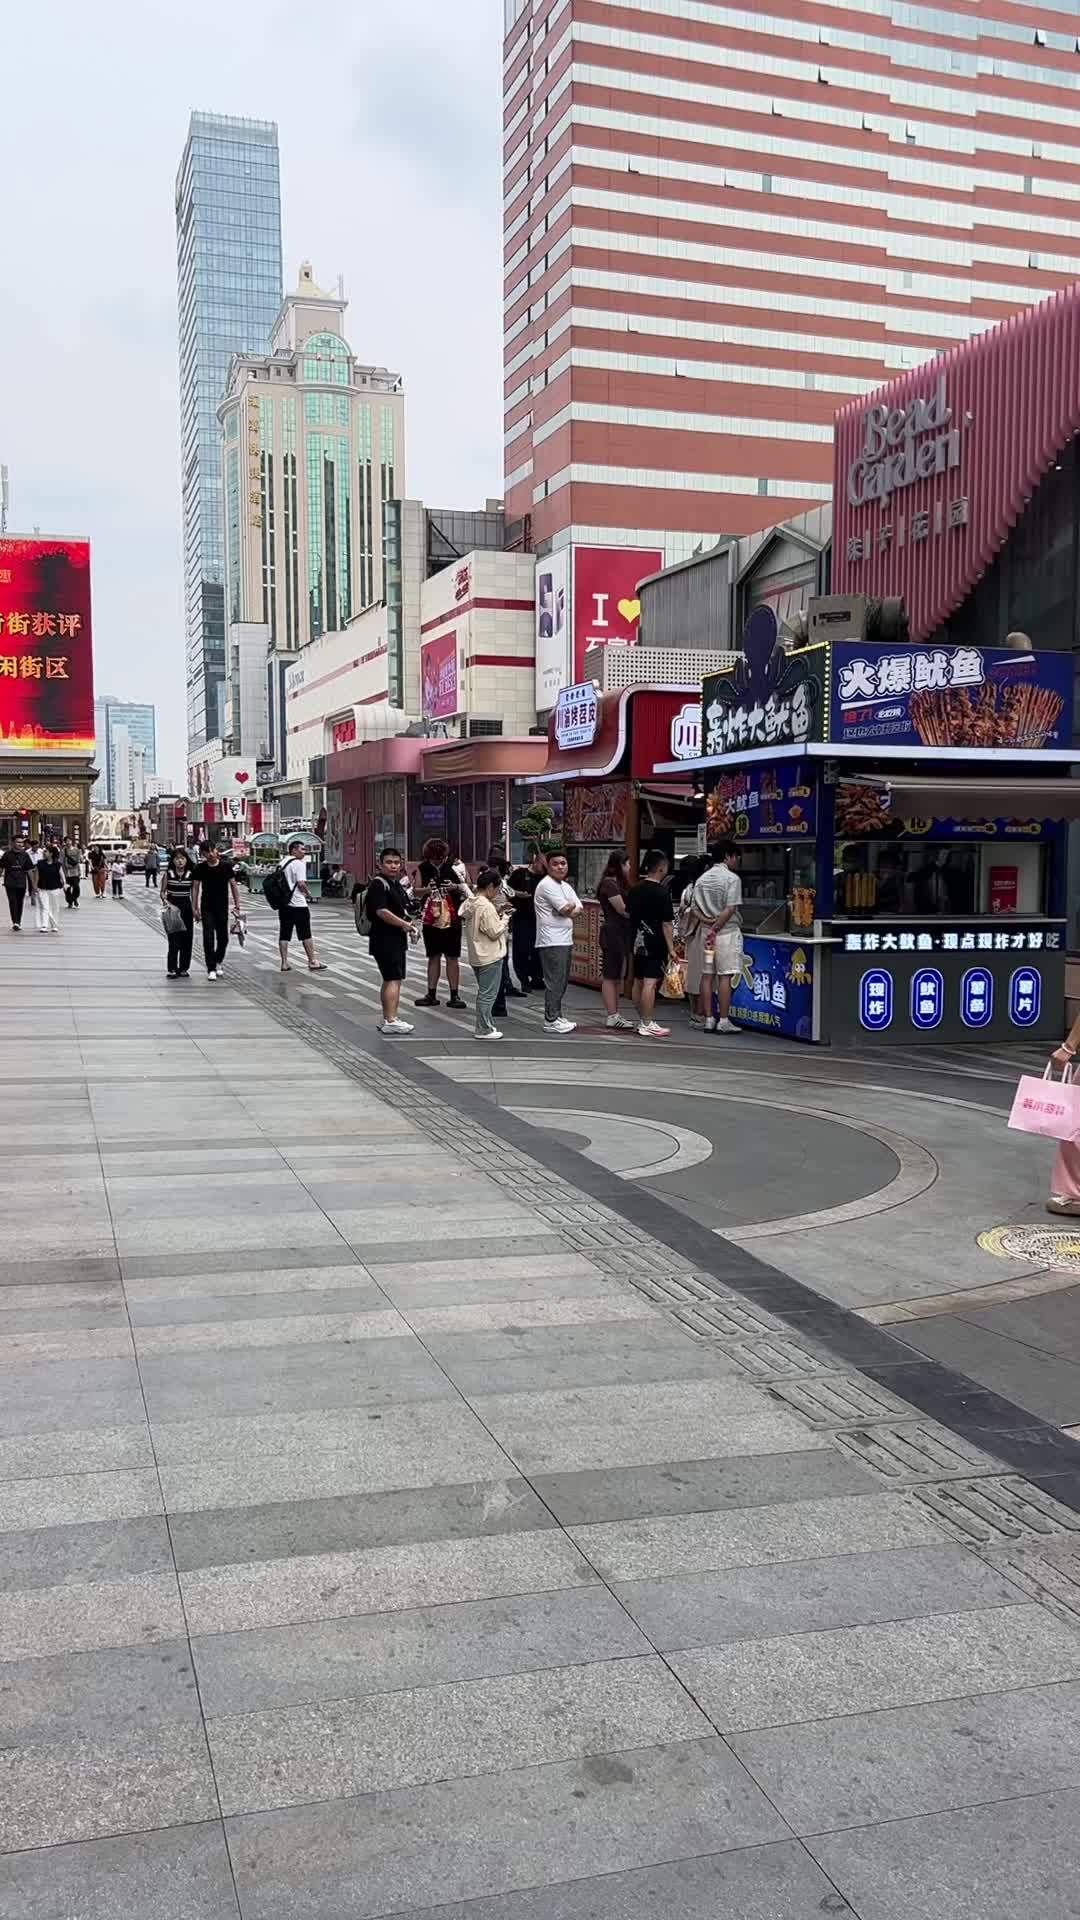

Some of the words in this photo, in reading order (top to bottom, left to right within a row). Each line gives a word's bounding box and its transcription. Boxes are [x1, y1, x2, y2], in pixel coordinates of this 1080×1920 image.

[863, 371, 952, 462] Bead
[847, 428, 960, 509] Garden
[0, 611, 82, 637] 街获评
[591, 593, 609, 627] I
[840, 649, 983, 698] 火爆鱿鱼
[677, 725, 697, 747] 川
[706, 684, 809, 755] 轰炸大鱿鱼
[725, 791, 760, 815] 大鱿鱼
[845, 933, 1059, 950] 轰炸大鱿鱼·现点现炸才好吃
[868, 982, 885, 1016] 现炸
[919, 982, 936, 1014] 鱿鱼
[969, 980, 985, 1013] 薯条
[1018, 980, 1033, 1012] 薯片
